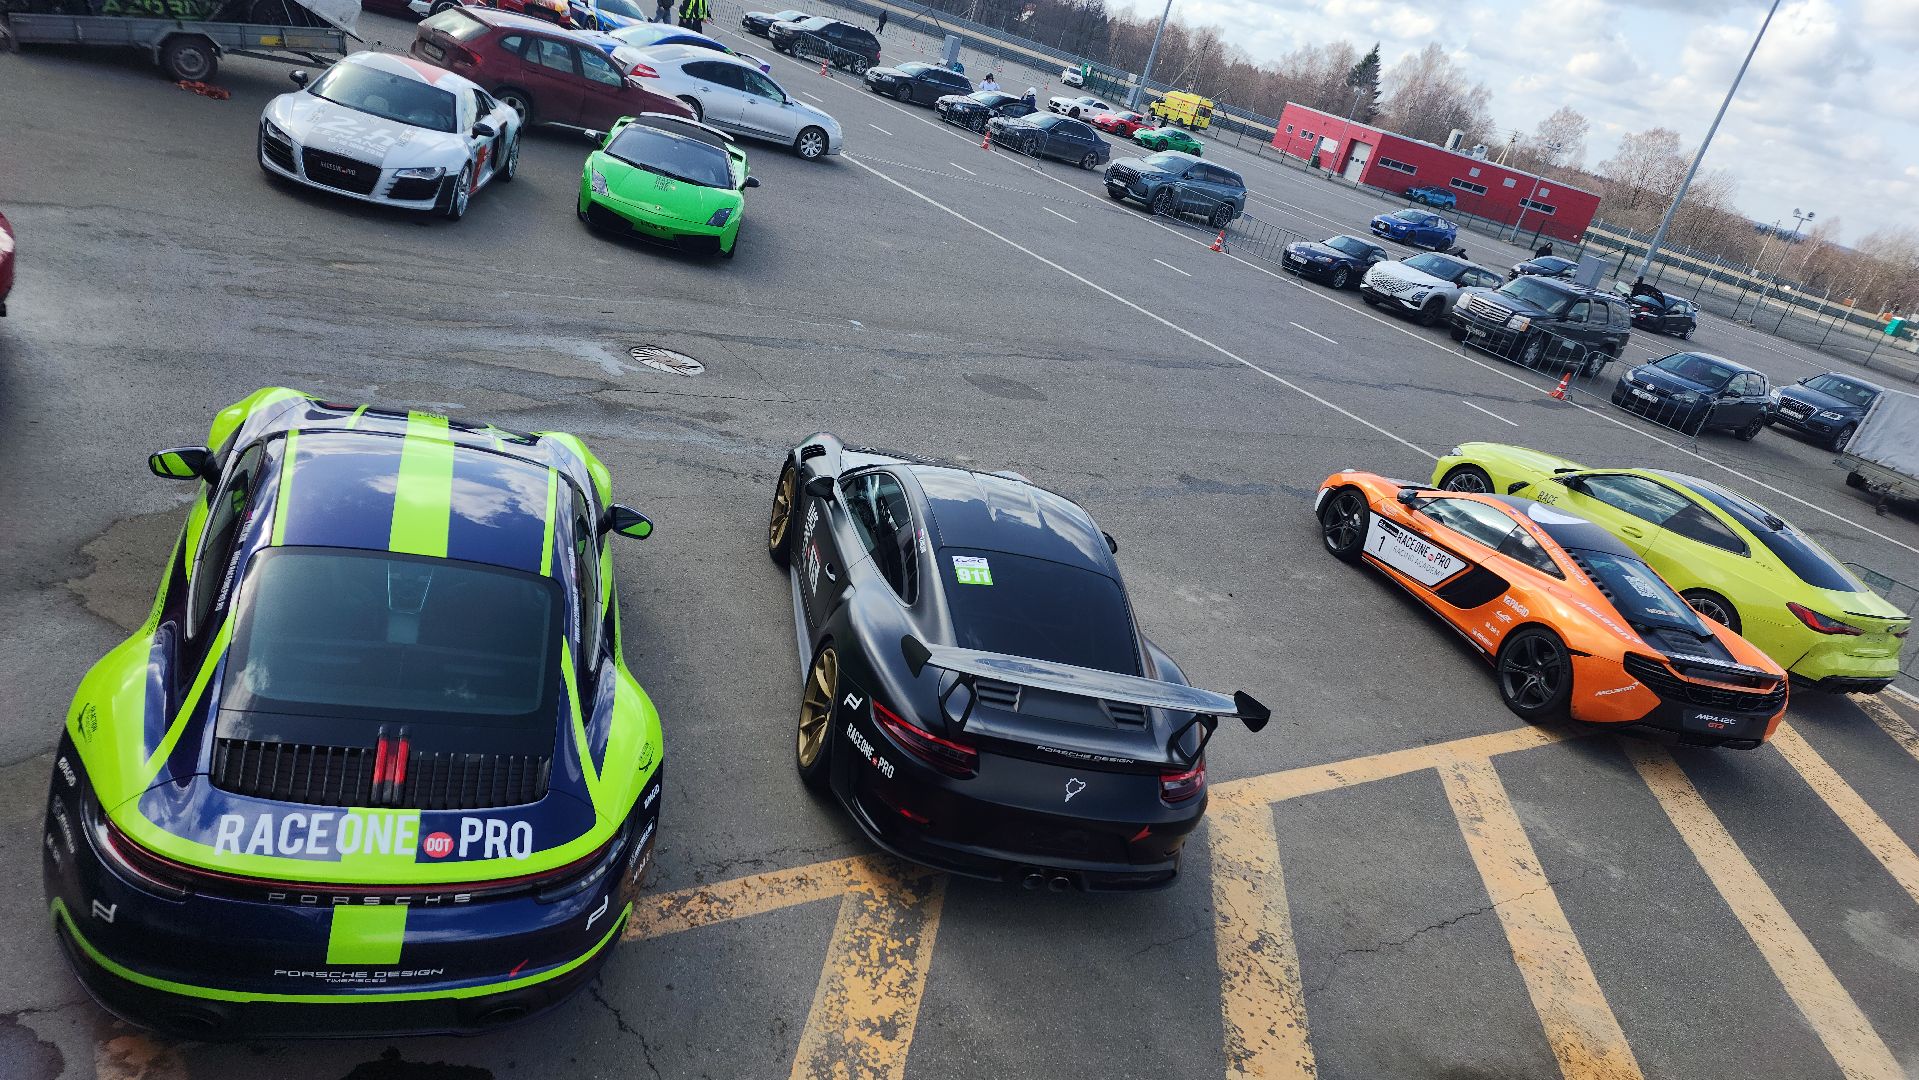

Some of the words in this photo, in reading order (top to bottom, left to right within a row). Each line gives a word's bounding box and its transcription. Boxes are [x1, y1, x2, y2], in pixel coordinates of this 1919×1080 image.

[1537, 491, 1558, 506] RACE
[1378, 535, 1386, 553] 1
[1433, 552, 1451, 570] PRO
[959, 569, 992, 583] 911
[1037, 745, 1092, 760] PORSCHE
[1094, 755, 1134, 764] DESIGN
[877, 756, 895, 779] PRO
[426, 837, 451, 853] DOT
[457, 816, 533, 861] PRO
[268, 892, 472, 906] PORSCHE
[274, 969, 368, 979] PORSCHE
[374, 968, 444, 979] DESIGN
